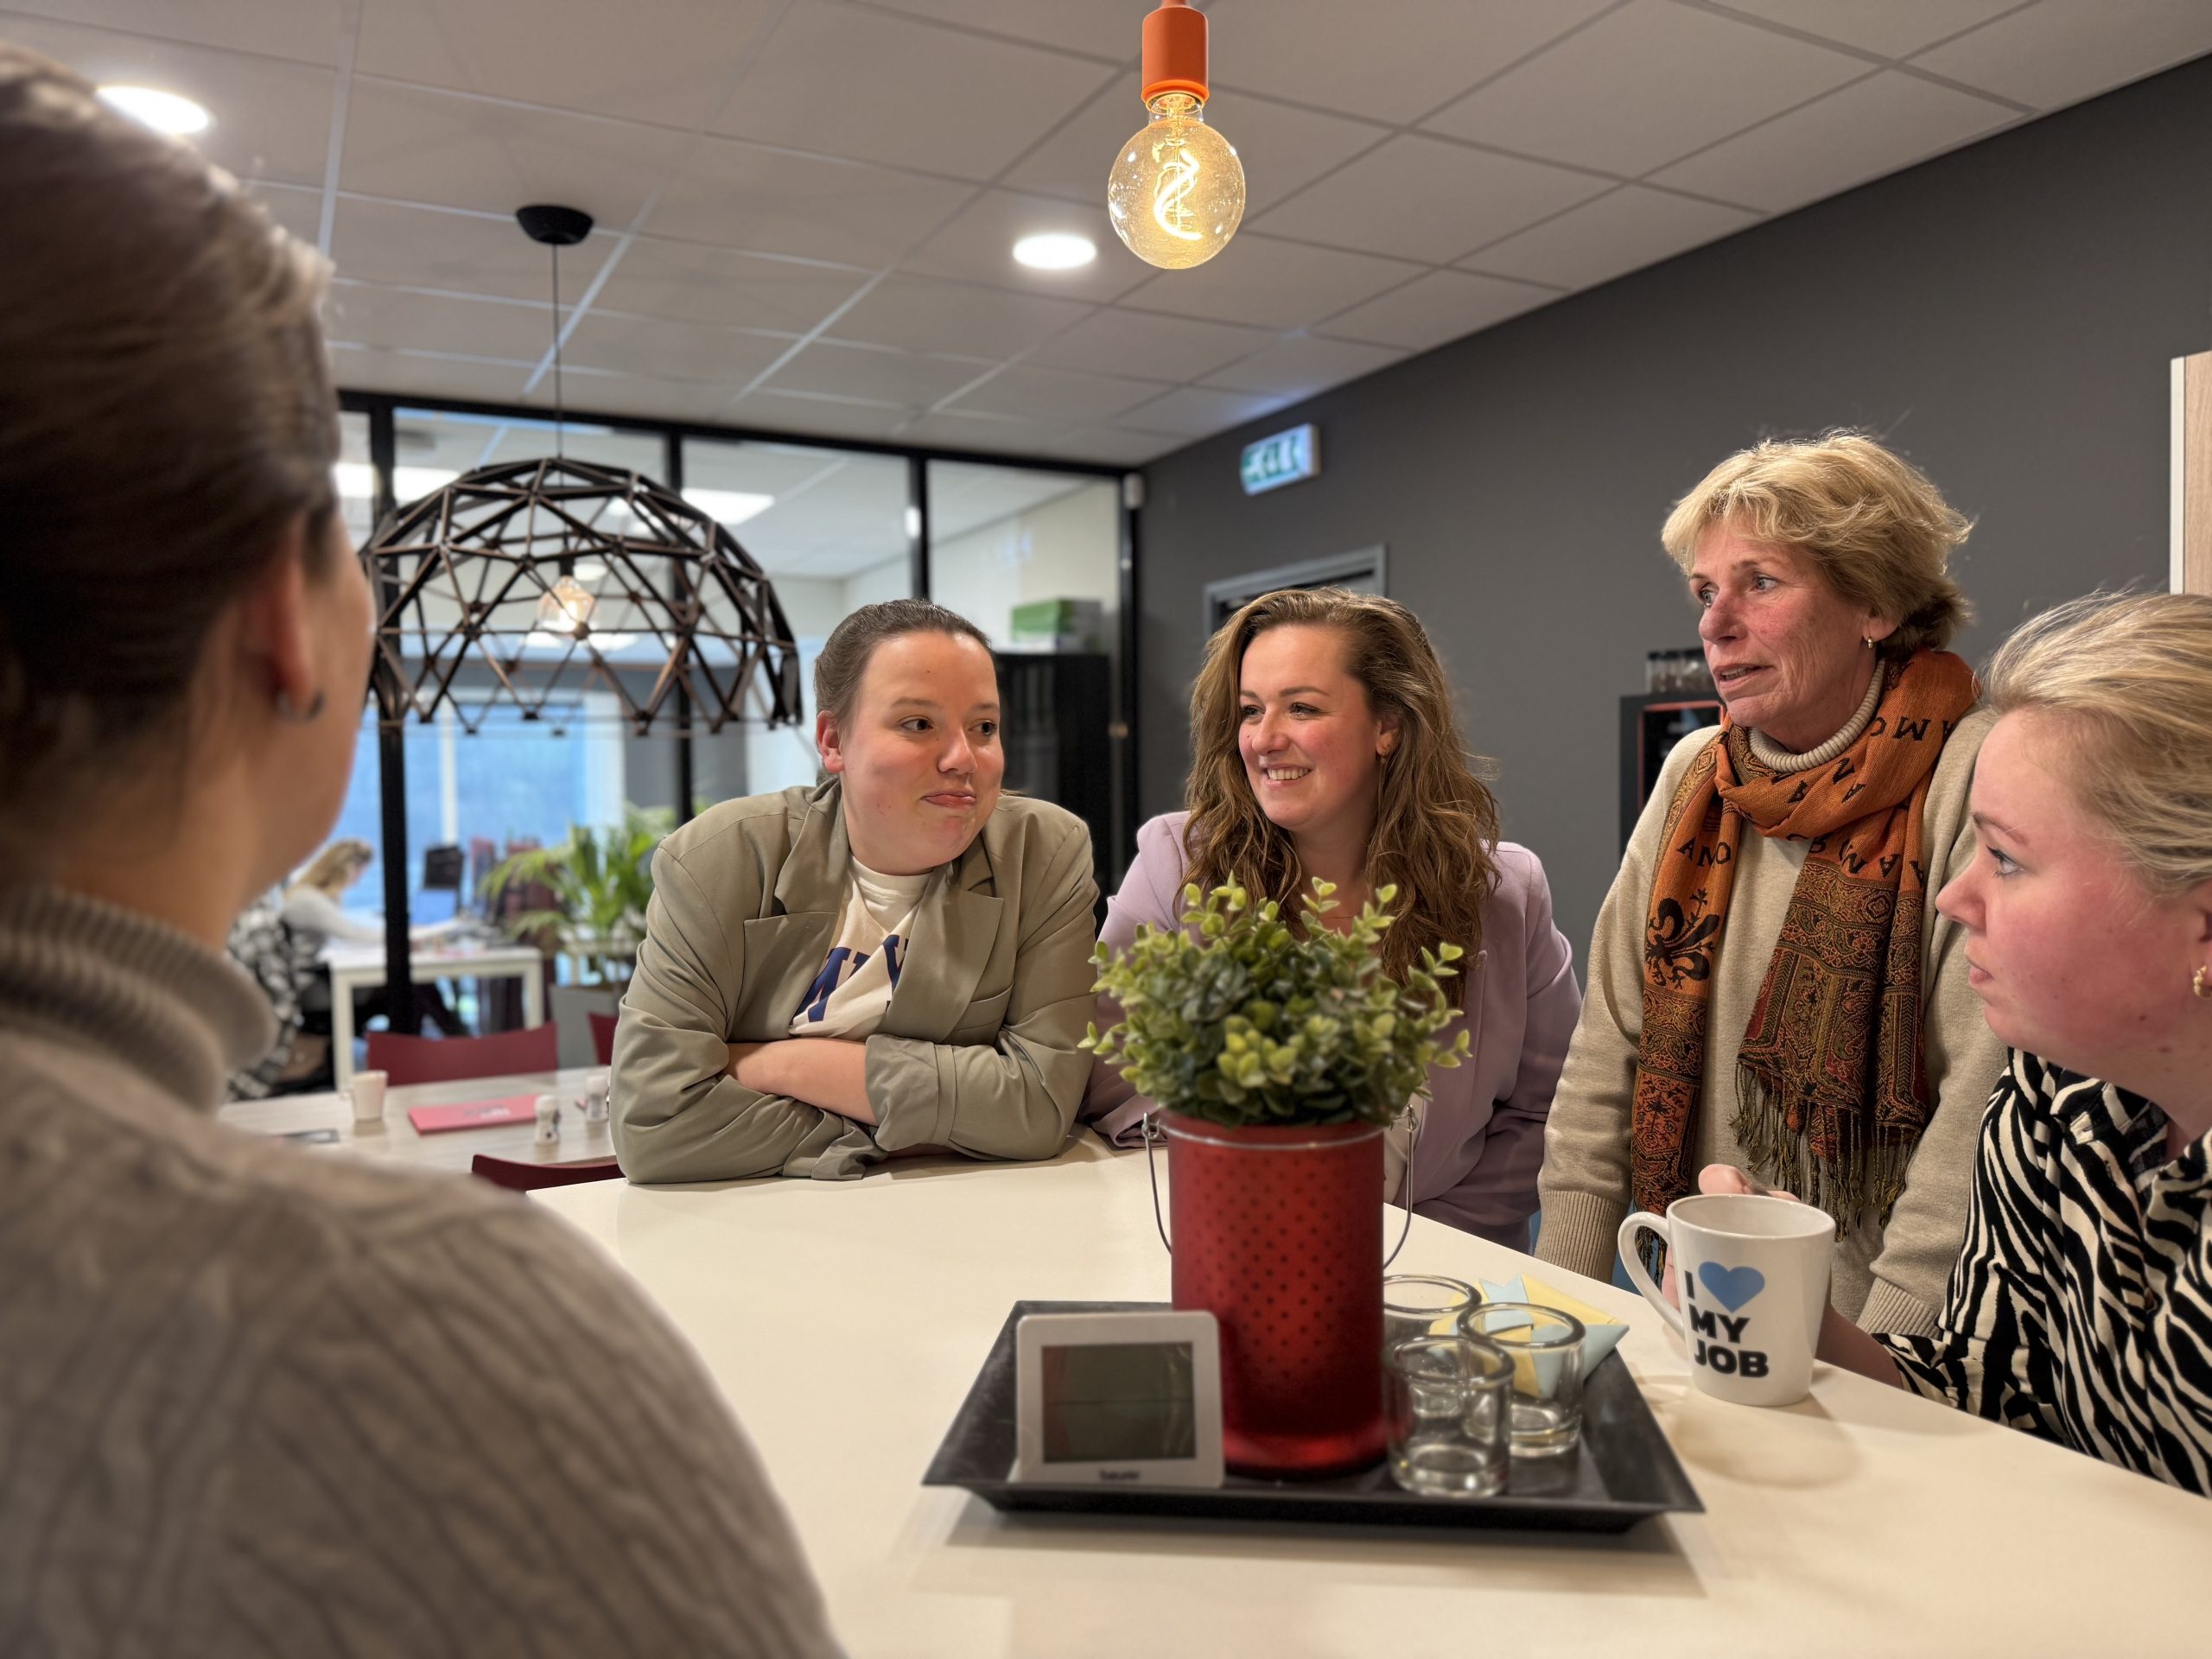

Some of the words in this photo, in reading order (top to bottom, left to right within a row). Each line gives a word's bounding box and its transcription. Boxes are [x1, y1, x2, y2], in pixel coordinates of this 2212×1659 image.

[1685, 1270, 1694, 1300] I
[1688, 1303, 1751, 1344] MY
[1694, 1338, 1769, 1378] JOB
